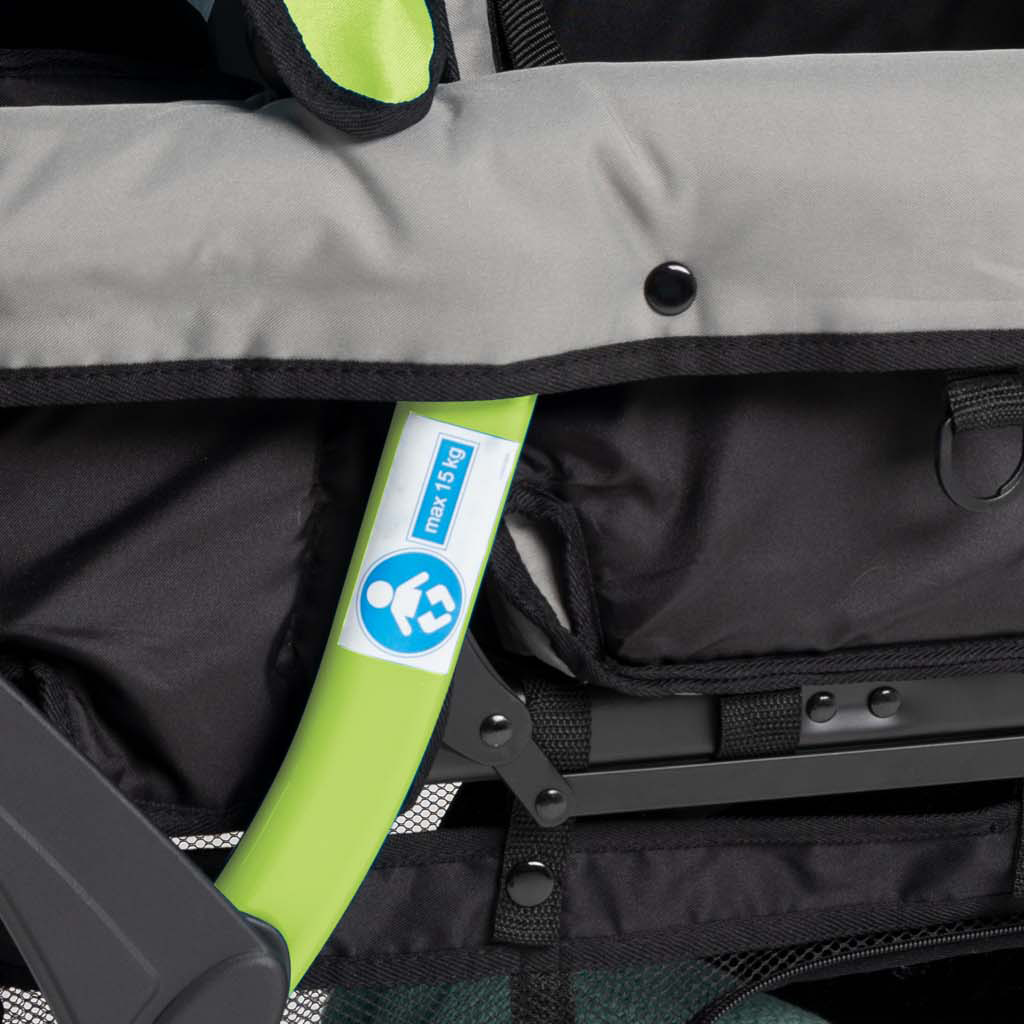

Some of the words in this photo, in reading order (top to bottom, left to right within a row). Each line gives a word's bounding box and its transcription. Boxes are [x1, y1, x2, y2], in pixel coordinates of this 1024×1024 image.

[441, 446, 467, 469] kg
[434, 470, 455, 491] 15
[424, 495, 448, 534] max
